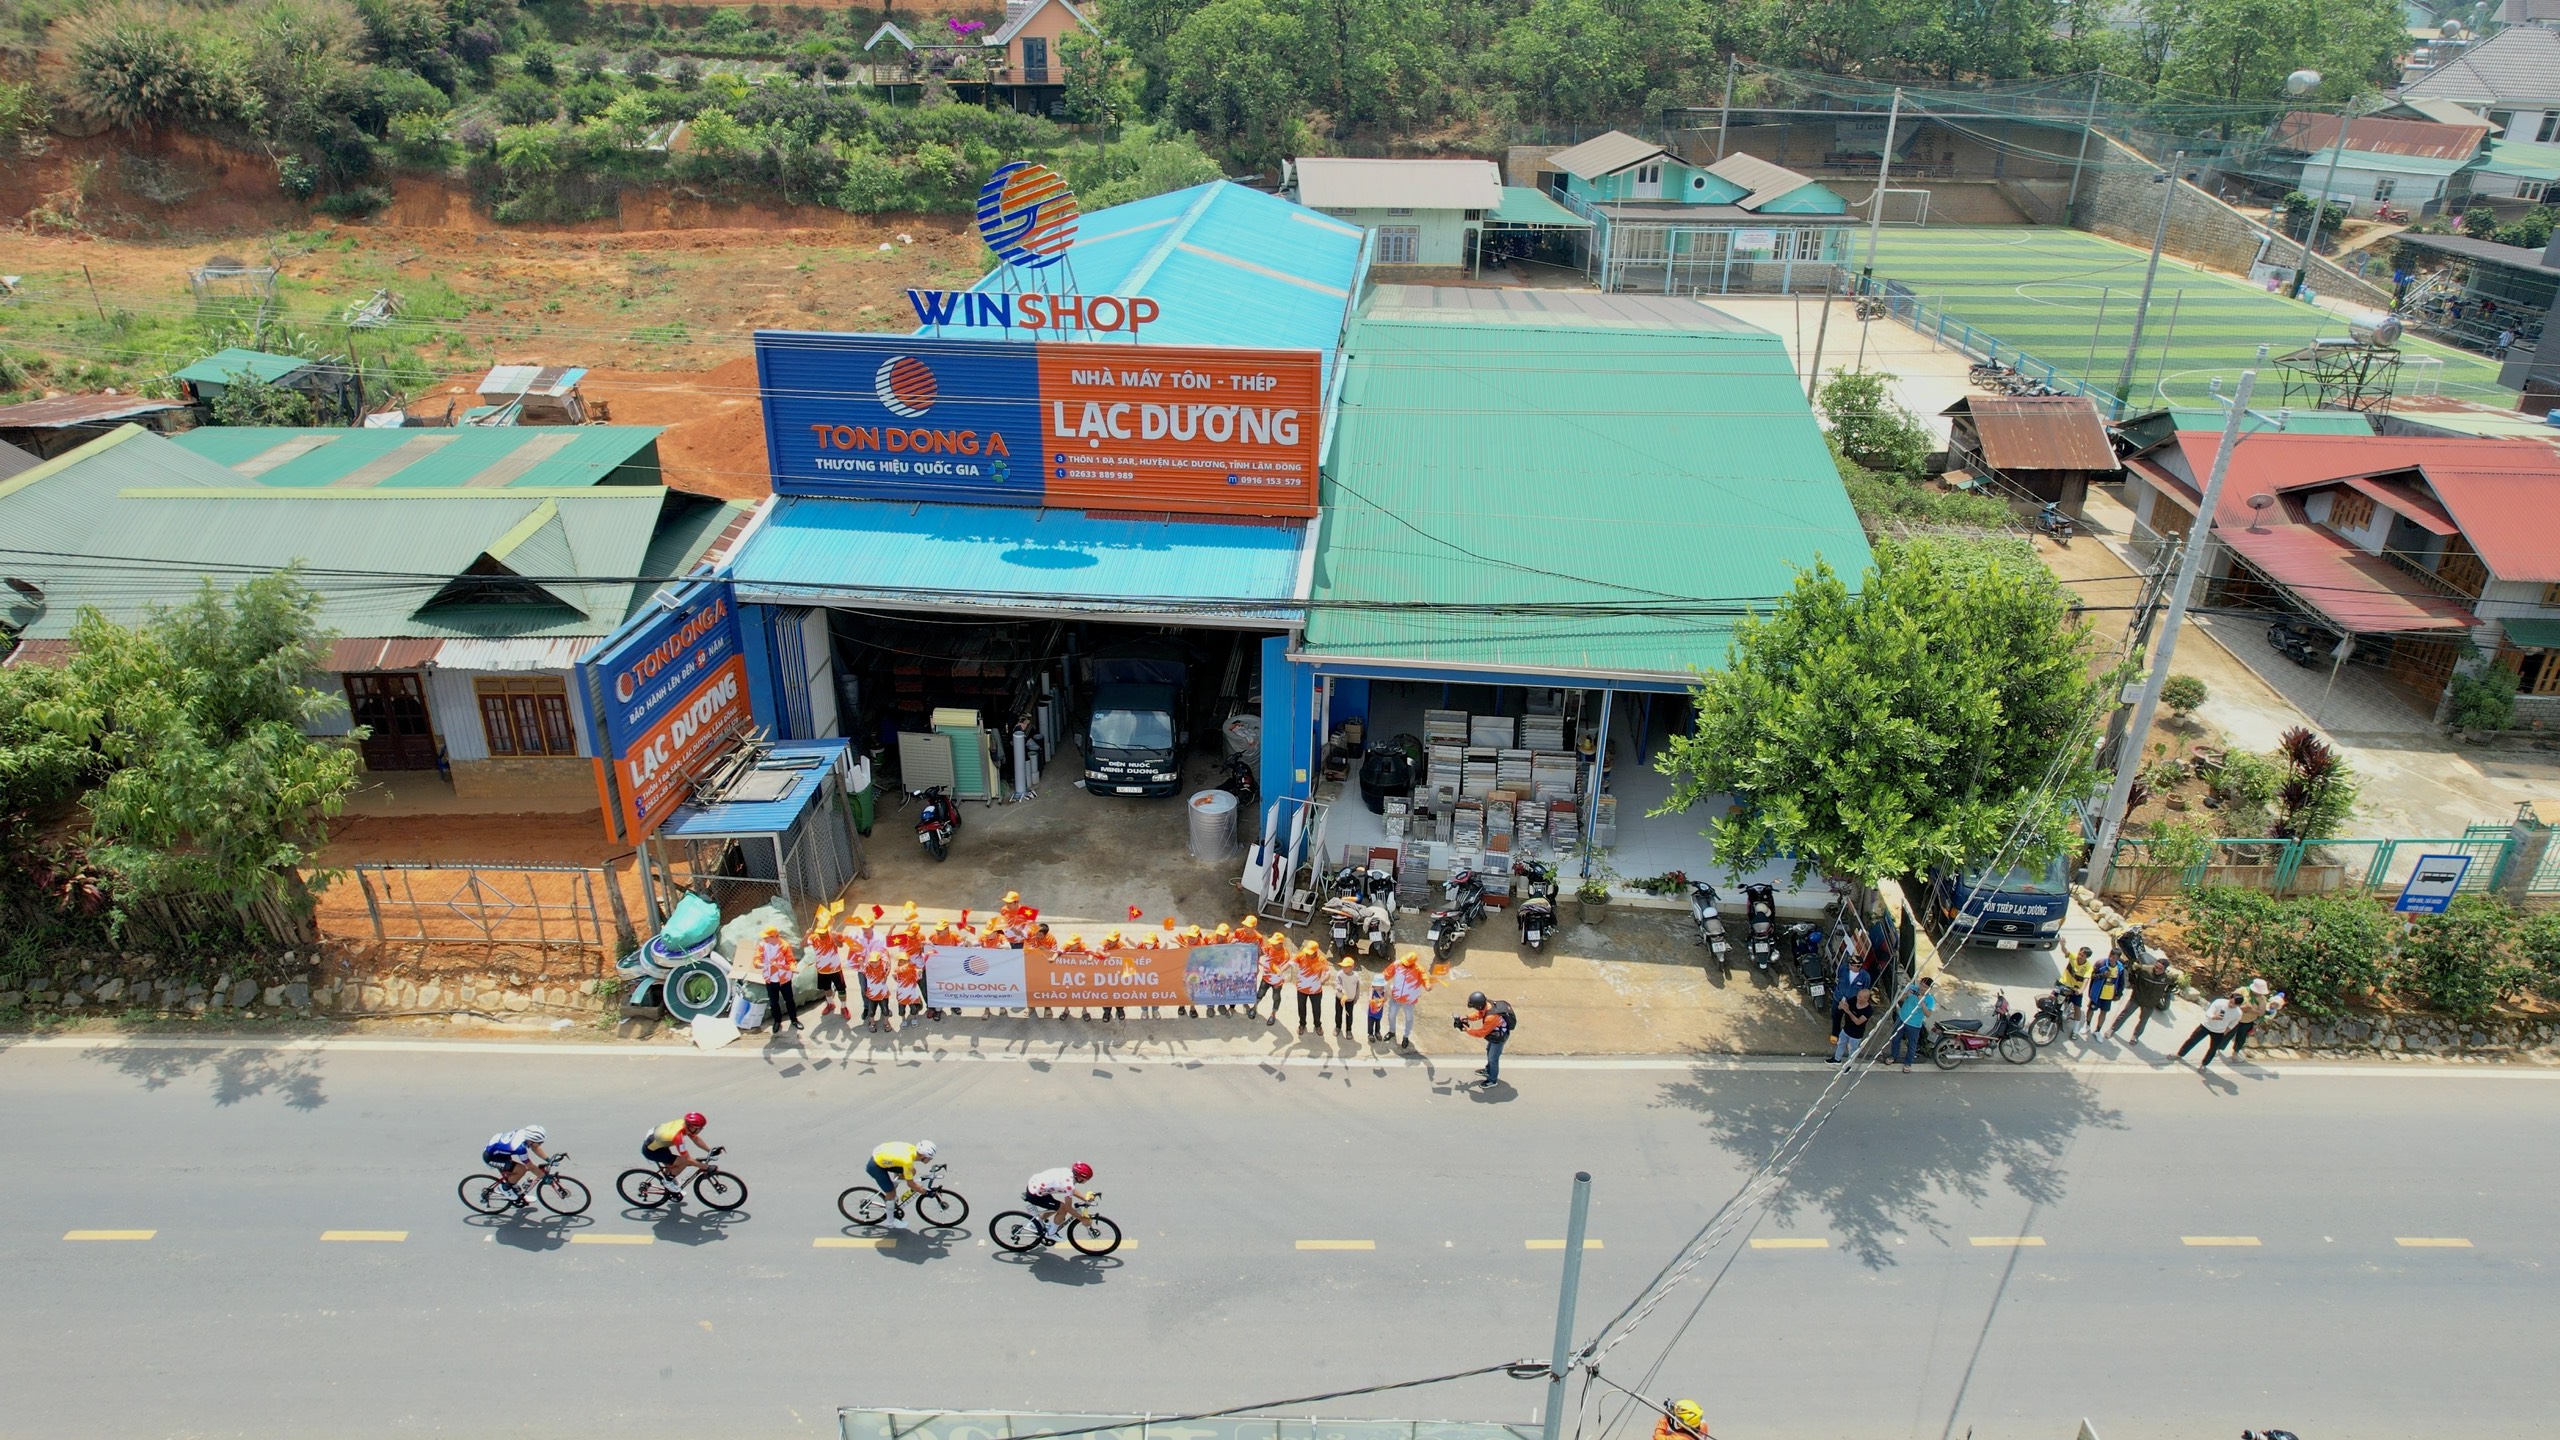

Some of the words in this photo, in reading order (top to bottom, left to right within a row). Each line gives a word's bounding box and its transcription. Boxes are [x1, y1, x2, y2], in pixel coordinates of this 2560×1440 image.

[1072, 367, 1115, 386] NHÀ
[1122, 368, 1163, 387] MÁY
[1170, 370, 1211, 389] TÔN
[1230, 372, 1277, 391] THÉP
[1053, 401, 1132, 448] LẠC
[1141, 404, 1299, 446] DƯƠNG
[811, 424, 880, 450] TON
[885, 427, 979, 455] DONG
[984, 432, 1010, 457] A
[815, 458, 876, 472] THƯƠNG
[880, 459, 909, 475] HIỆU
[914, 460, 952, 475] QUỐC
[955, 464, 980, 476] GIA
[1068, 455, 1095, 464] THÔN
[1139, 457, 1170, 468] HUYỆN
[1171, 459, 1188, 469] LẠC
[1252, 461, 1273, 470] LÂM
[1275, 461, 1302, 471] ĐỒNG
[1069, 470, 1096, 478] 02633
[1099, 471, 1115, 479] 889
[1240, 476, 1262, 484] 0916
[1266, 477, 1281, 485] 153
[1284, 478, 1302, 487] 579
[632, 641, 671, 686] TON
[669, 606, 715, 659] DONG
[714, 598, 728, 623] A
[629, 706, 645, 725] BẢO
[645, 687, 667, 710] HÀNH
[667, 674, 680, 692] LÊN
[681, 661, 695, 680] ĐẾN
[698, 652, 706, 666] 50
[708, 637, 724, 656] NĂM
[630, 734, 669, 789] LẠC
[671, 672, 737, 750] DƯƠNG
[1997, 902, 2013, 913] THÉP
[2013, 904, 2026, 916] LẠC
[936, 982, 964, 990] TON
[1050, 972, 1086, 989] LẠC
[1033, 991, 1067, 999] CHÀO
[1071, 991, 1108, 999] MỪNG
[1113, 991, 1147, 999] ĐOÀN
[1151, 991, 1177, 999] ĐUA
